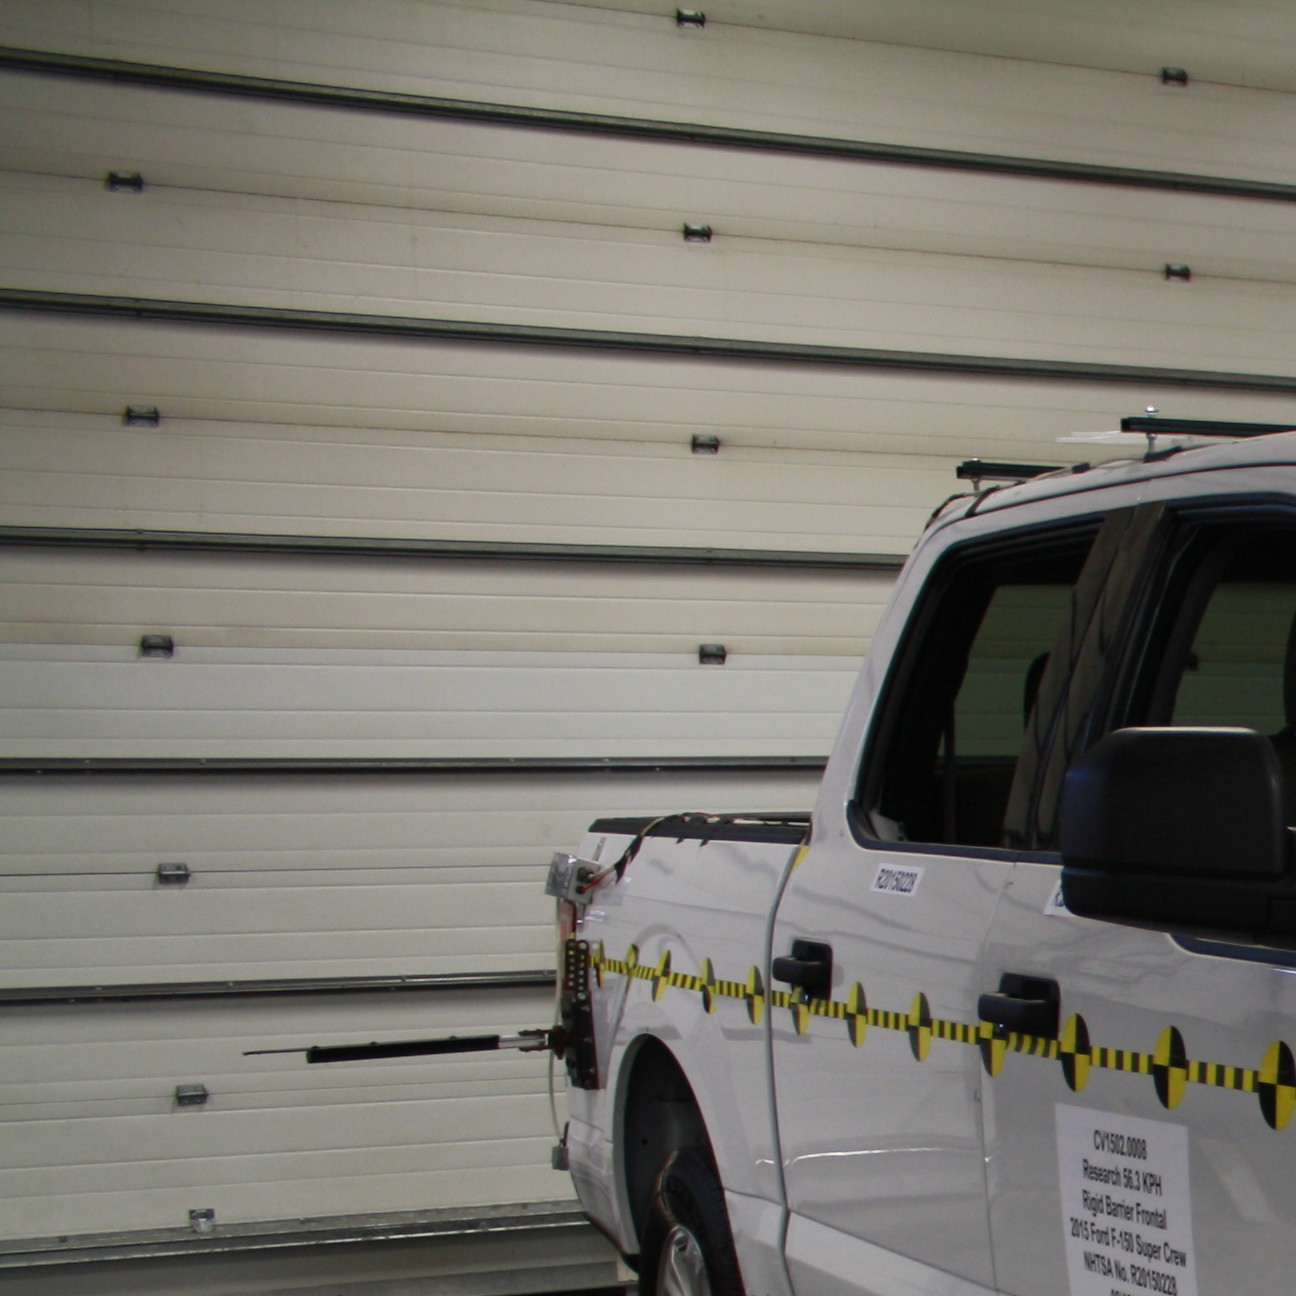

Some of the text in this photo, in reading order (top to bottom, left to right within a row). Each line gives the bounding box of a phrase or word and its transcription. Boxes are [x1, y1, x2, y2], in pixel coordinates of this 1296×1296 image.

[1093, 1129, 1147, 1160] CV1502.0008
[1082, 1158, 1162, 1196] Research 56.3 KPH
[1082, 1190, 1167, 1231] Rigid Barrier Frontal
[1070, 1217, 1186, 1268] 2015 Ford F-150 Super Crew
[1083, 1251, 1177, 1296] NHTSA No. R20150228
